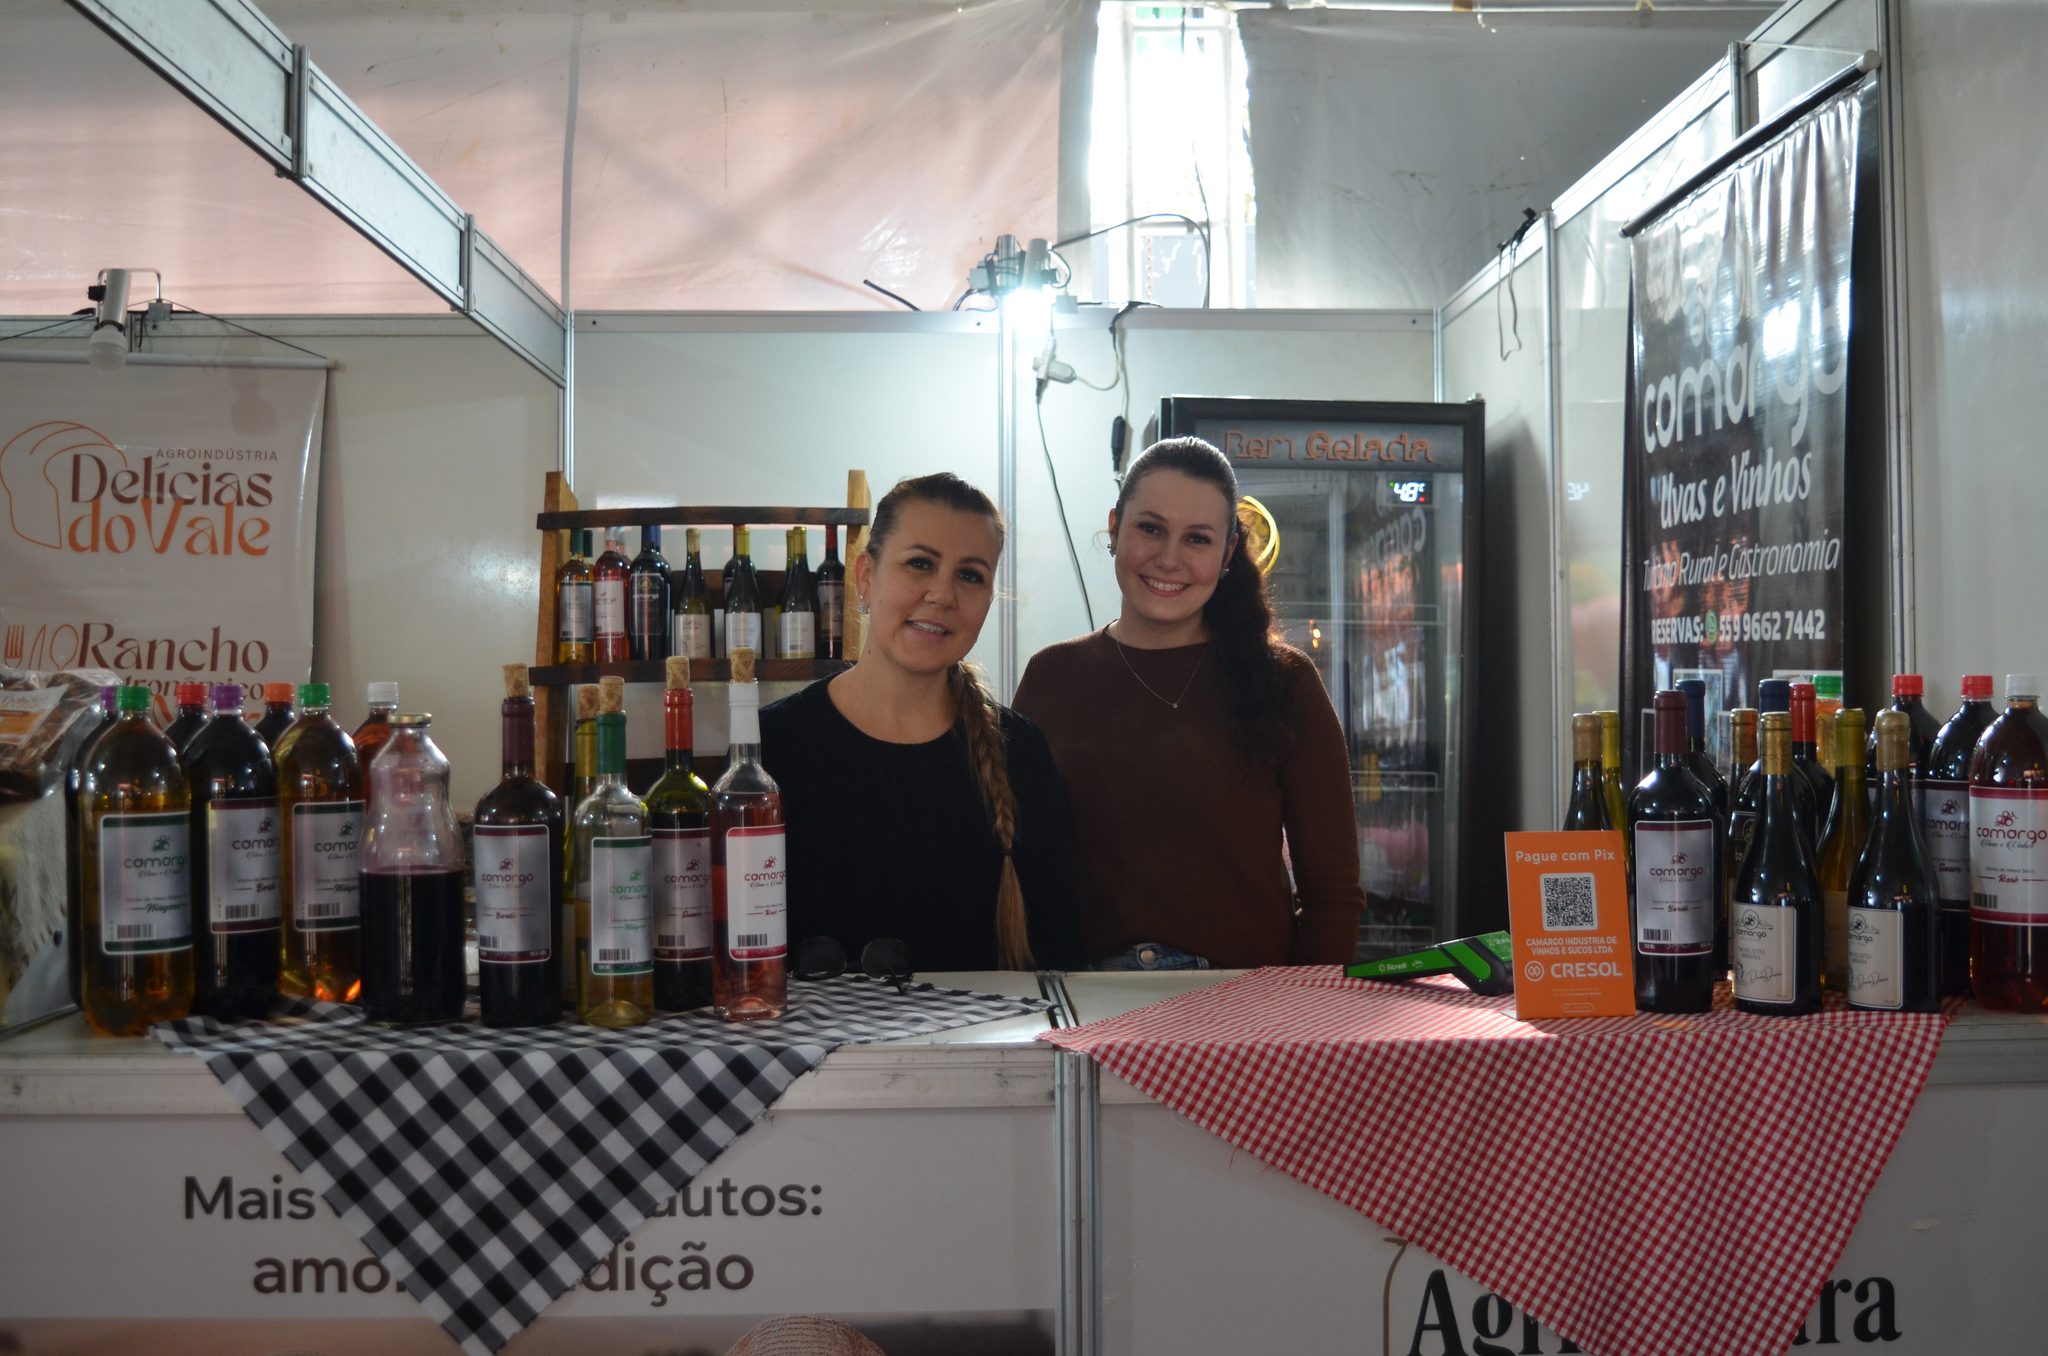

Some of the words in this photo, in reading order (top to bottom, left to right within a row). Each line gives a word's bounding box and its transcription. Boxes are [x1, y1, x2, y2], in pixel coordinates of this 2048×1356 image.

[156, 448, 279, 462] AGROINDÚSTRIA
[1304, 430, 1434, 464] Gelada
[72, 453, 273, 508] Delícias
[1713, 475, 1727, 519] e
[1731, 446, 1812, 516] Vinhos
[1678, 544, 1718, 587] Rural
[1718, 552, 1728, 582] e
[1729, 528, 1841, 581] Gastronomia
[1651, 614, 1704, 645] RESERVAS:
[1742, 610, 1781, 642] 9662
[1784, 608, 1826, 641] 7442
[79, 623, 270, 673] Rancho
[1977, 827, 2047, 845] camargo
[124, 855, 188, 873] camarg
[1516, 850, 1557, 864] Pague
[1562, 851, 1590, 861] com
[1594, 849, 1615, 861] Pix
[481, 872, 534, 885] camargo
[1649, 866, 1703, 879] camargo
[1526, 937, 1564, 947] CAMARGO
[1565, 936, 1605, 946] INDUSTRIA
[1606, 936, 1617, 945] DE
[1531, 947, 1560, 955] VINHOS
[1561, 946, 1567, 954] E
[1568, 946, 1593, 954] SUCOS
[1594, 945, 1613, 953] LTDA
[1551, 961, 1624, 978] CRESOL
[184, 1175, 317, 1221] Mais
[252, 1256, 407, 1294] amo
